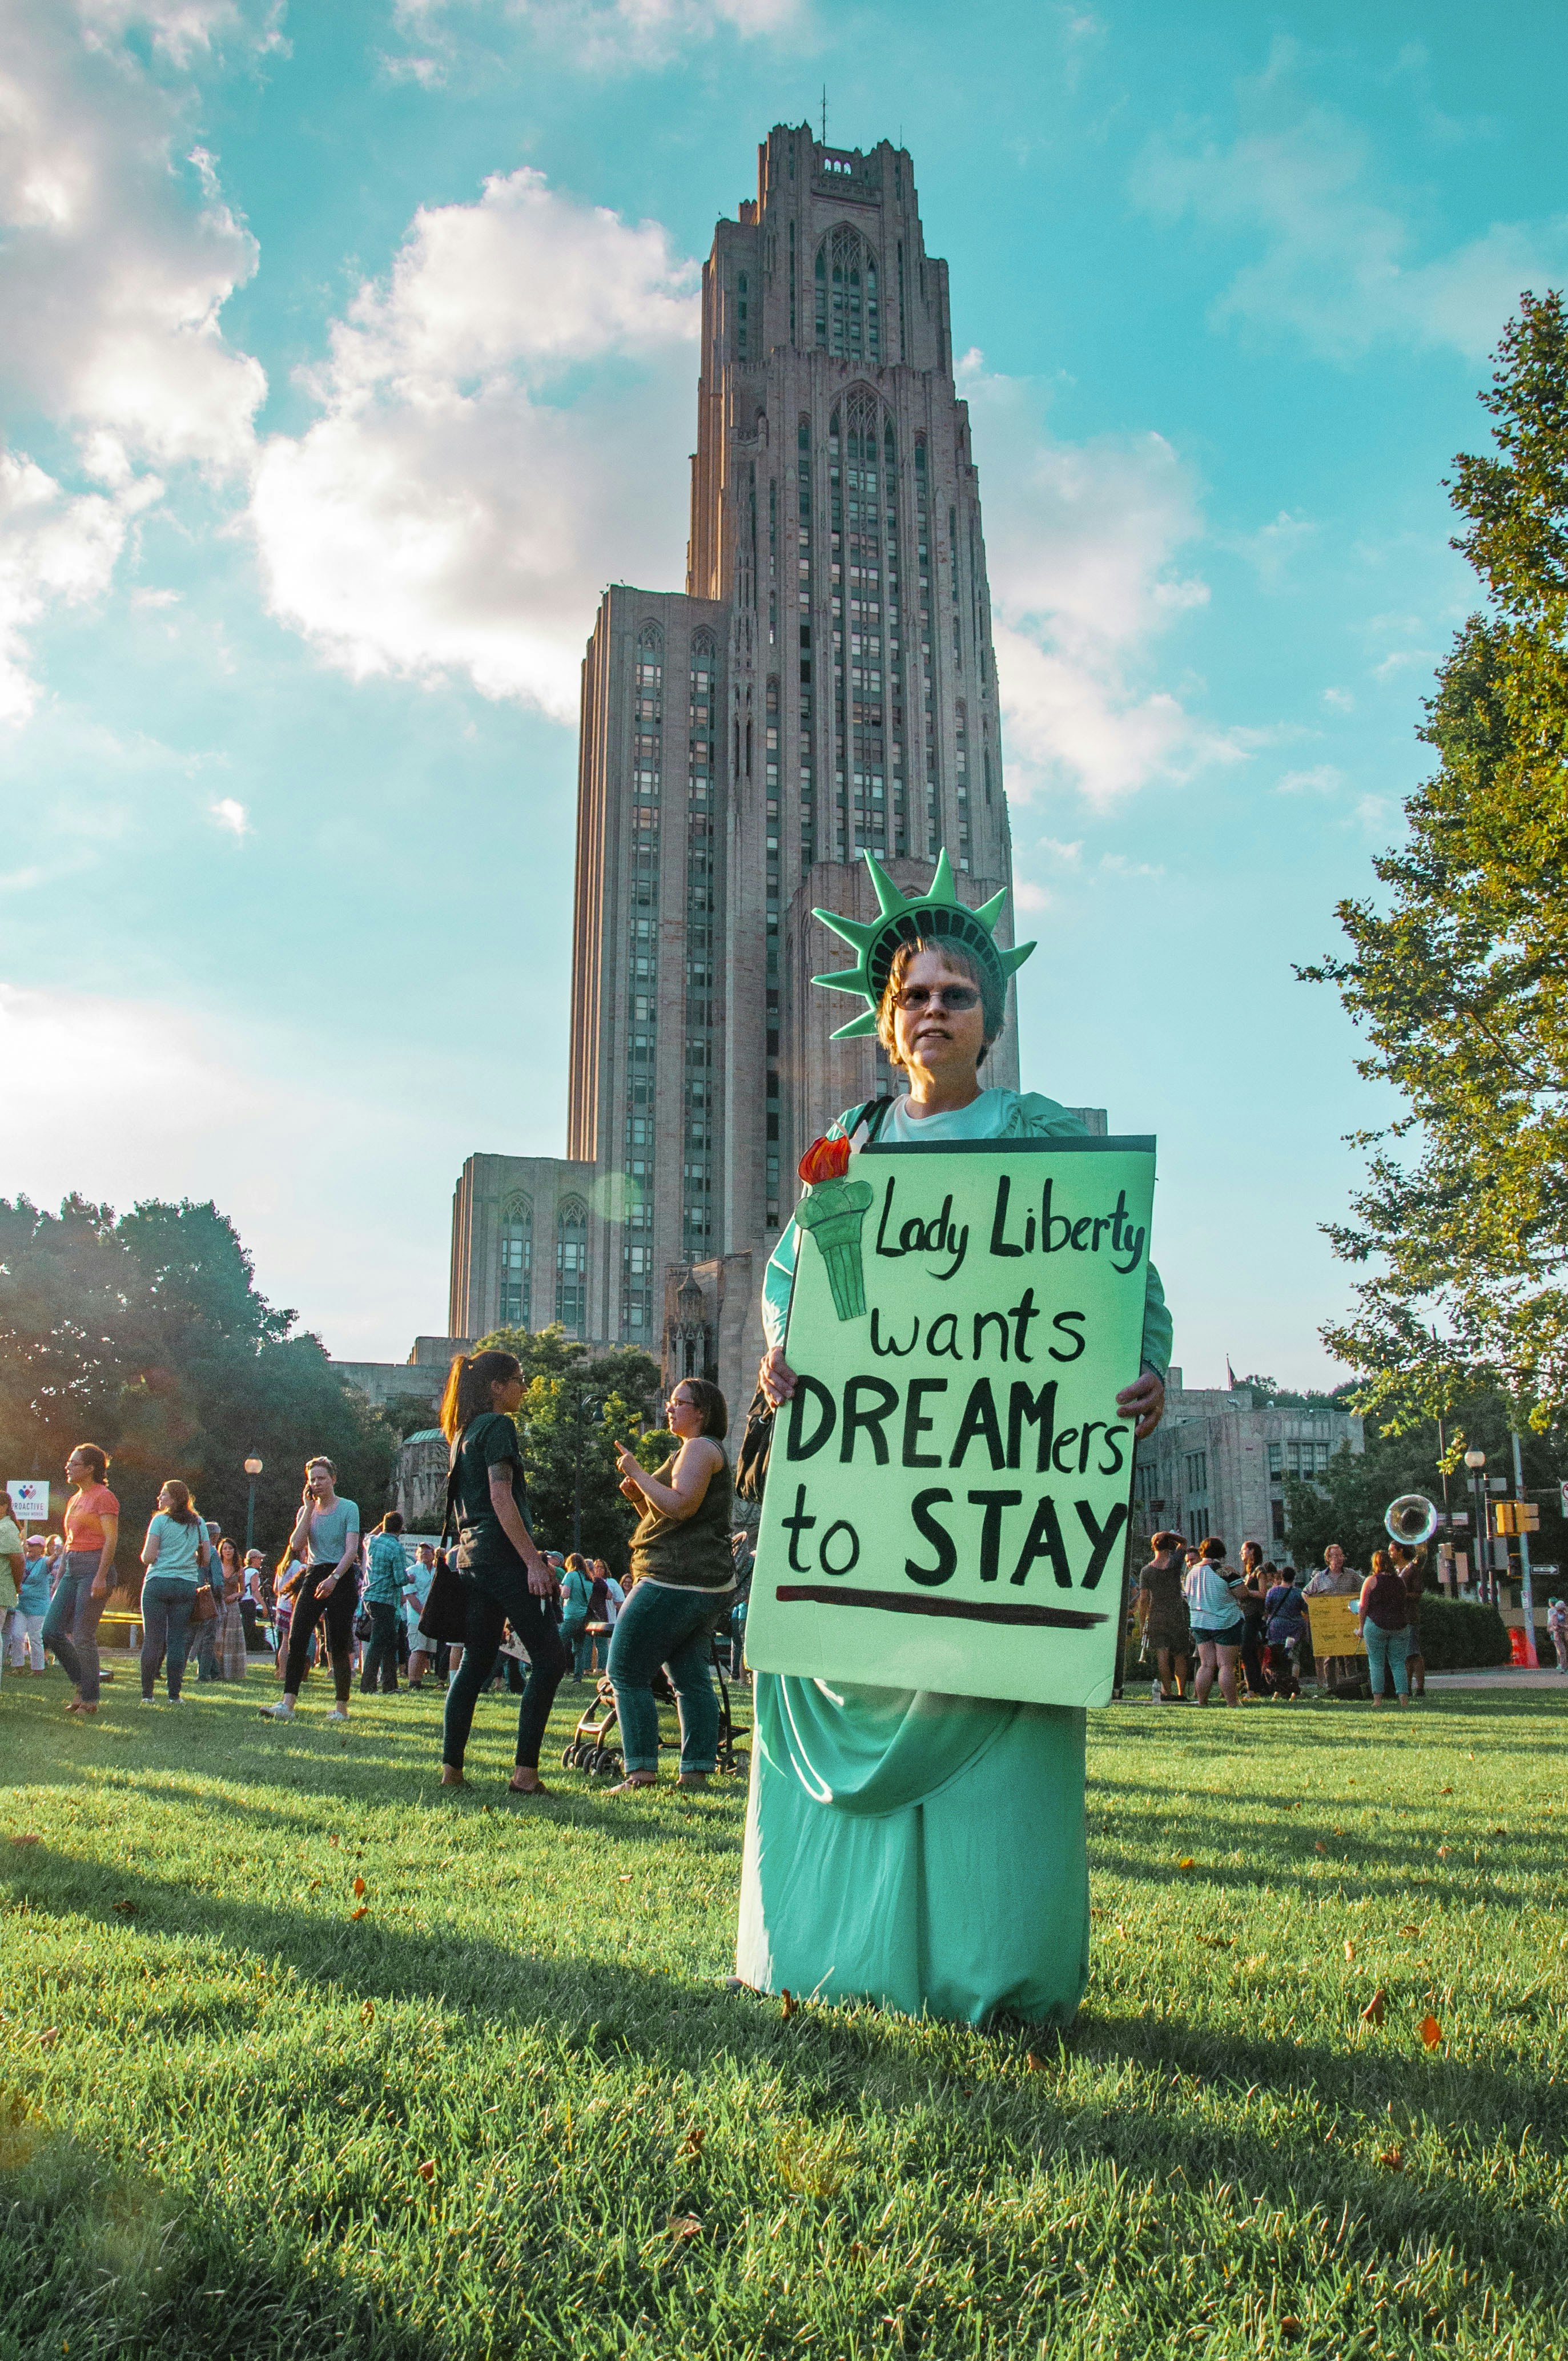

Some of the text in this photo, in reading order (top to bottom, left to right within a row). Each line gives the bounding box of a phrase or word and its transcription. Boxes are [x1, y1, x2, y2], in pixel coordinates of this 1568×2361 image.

[875, 1175, 1145, 1281] Lady Liberty
[870, 1288, 1086, 1363] wants
[786, 1374, 1129, 1475] DREAMers
[781, 1483, 1128, 1589] to STAY
